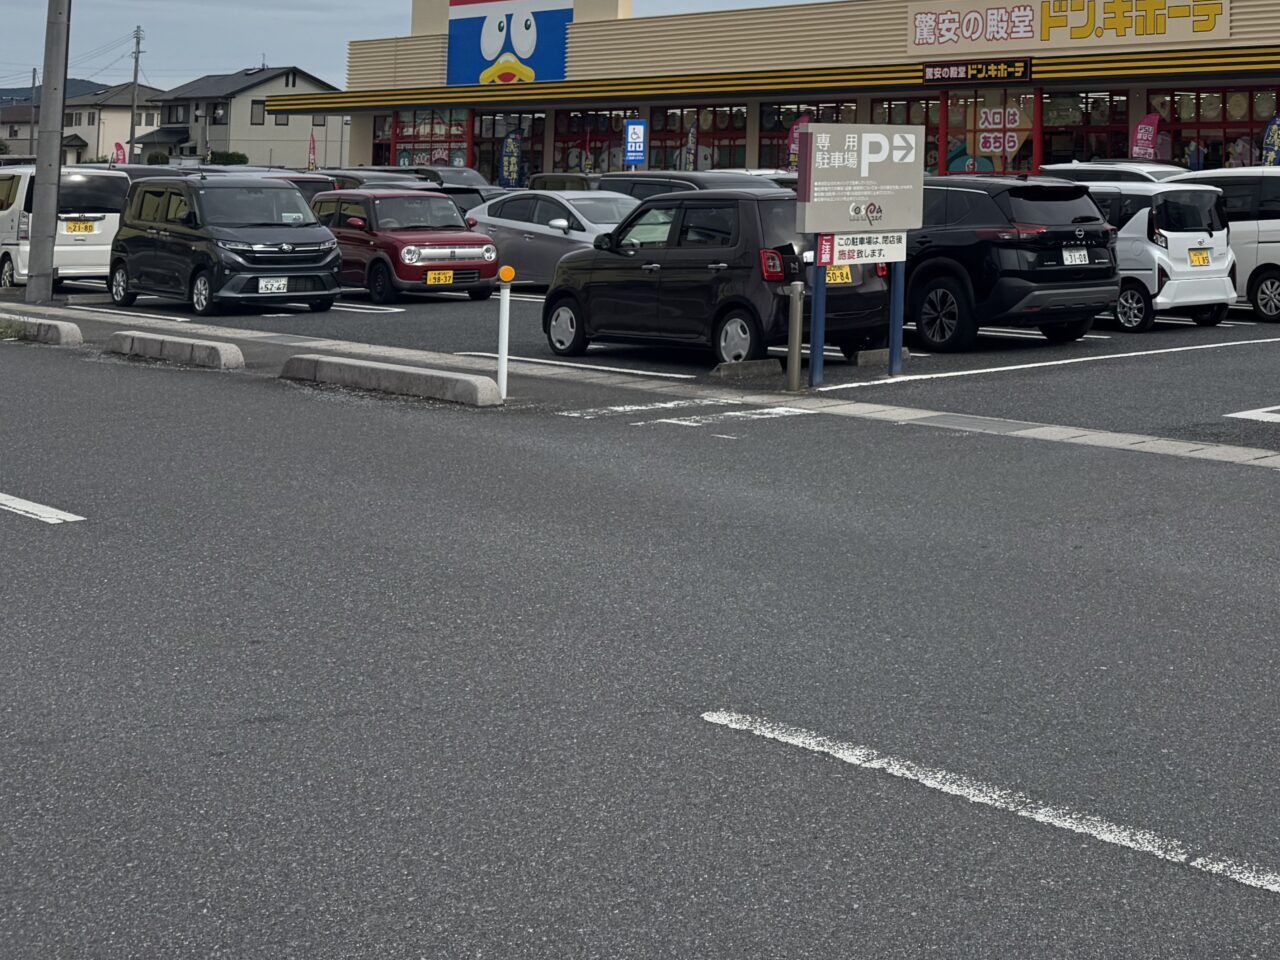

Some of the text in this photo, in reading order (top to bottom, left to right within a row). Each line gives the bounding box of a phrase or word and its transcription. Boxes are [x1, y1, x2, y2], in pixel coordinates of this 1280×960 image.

[980, 109, 1020, 128] 入口は
[980, 132, 1018, 152] あちら
[815, 151, 858, 169] 駐車場
[861, 133, 890, 177] P
